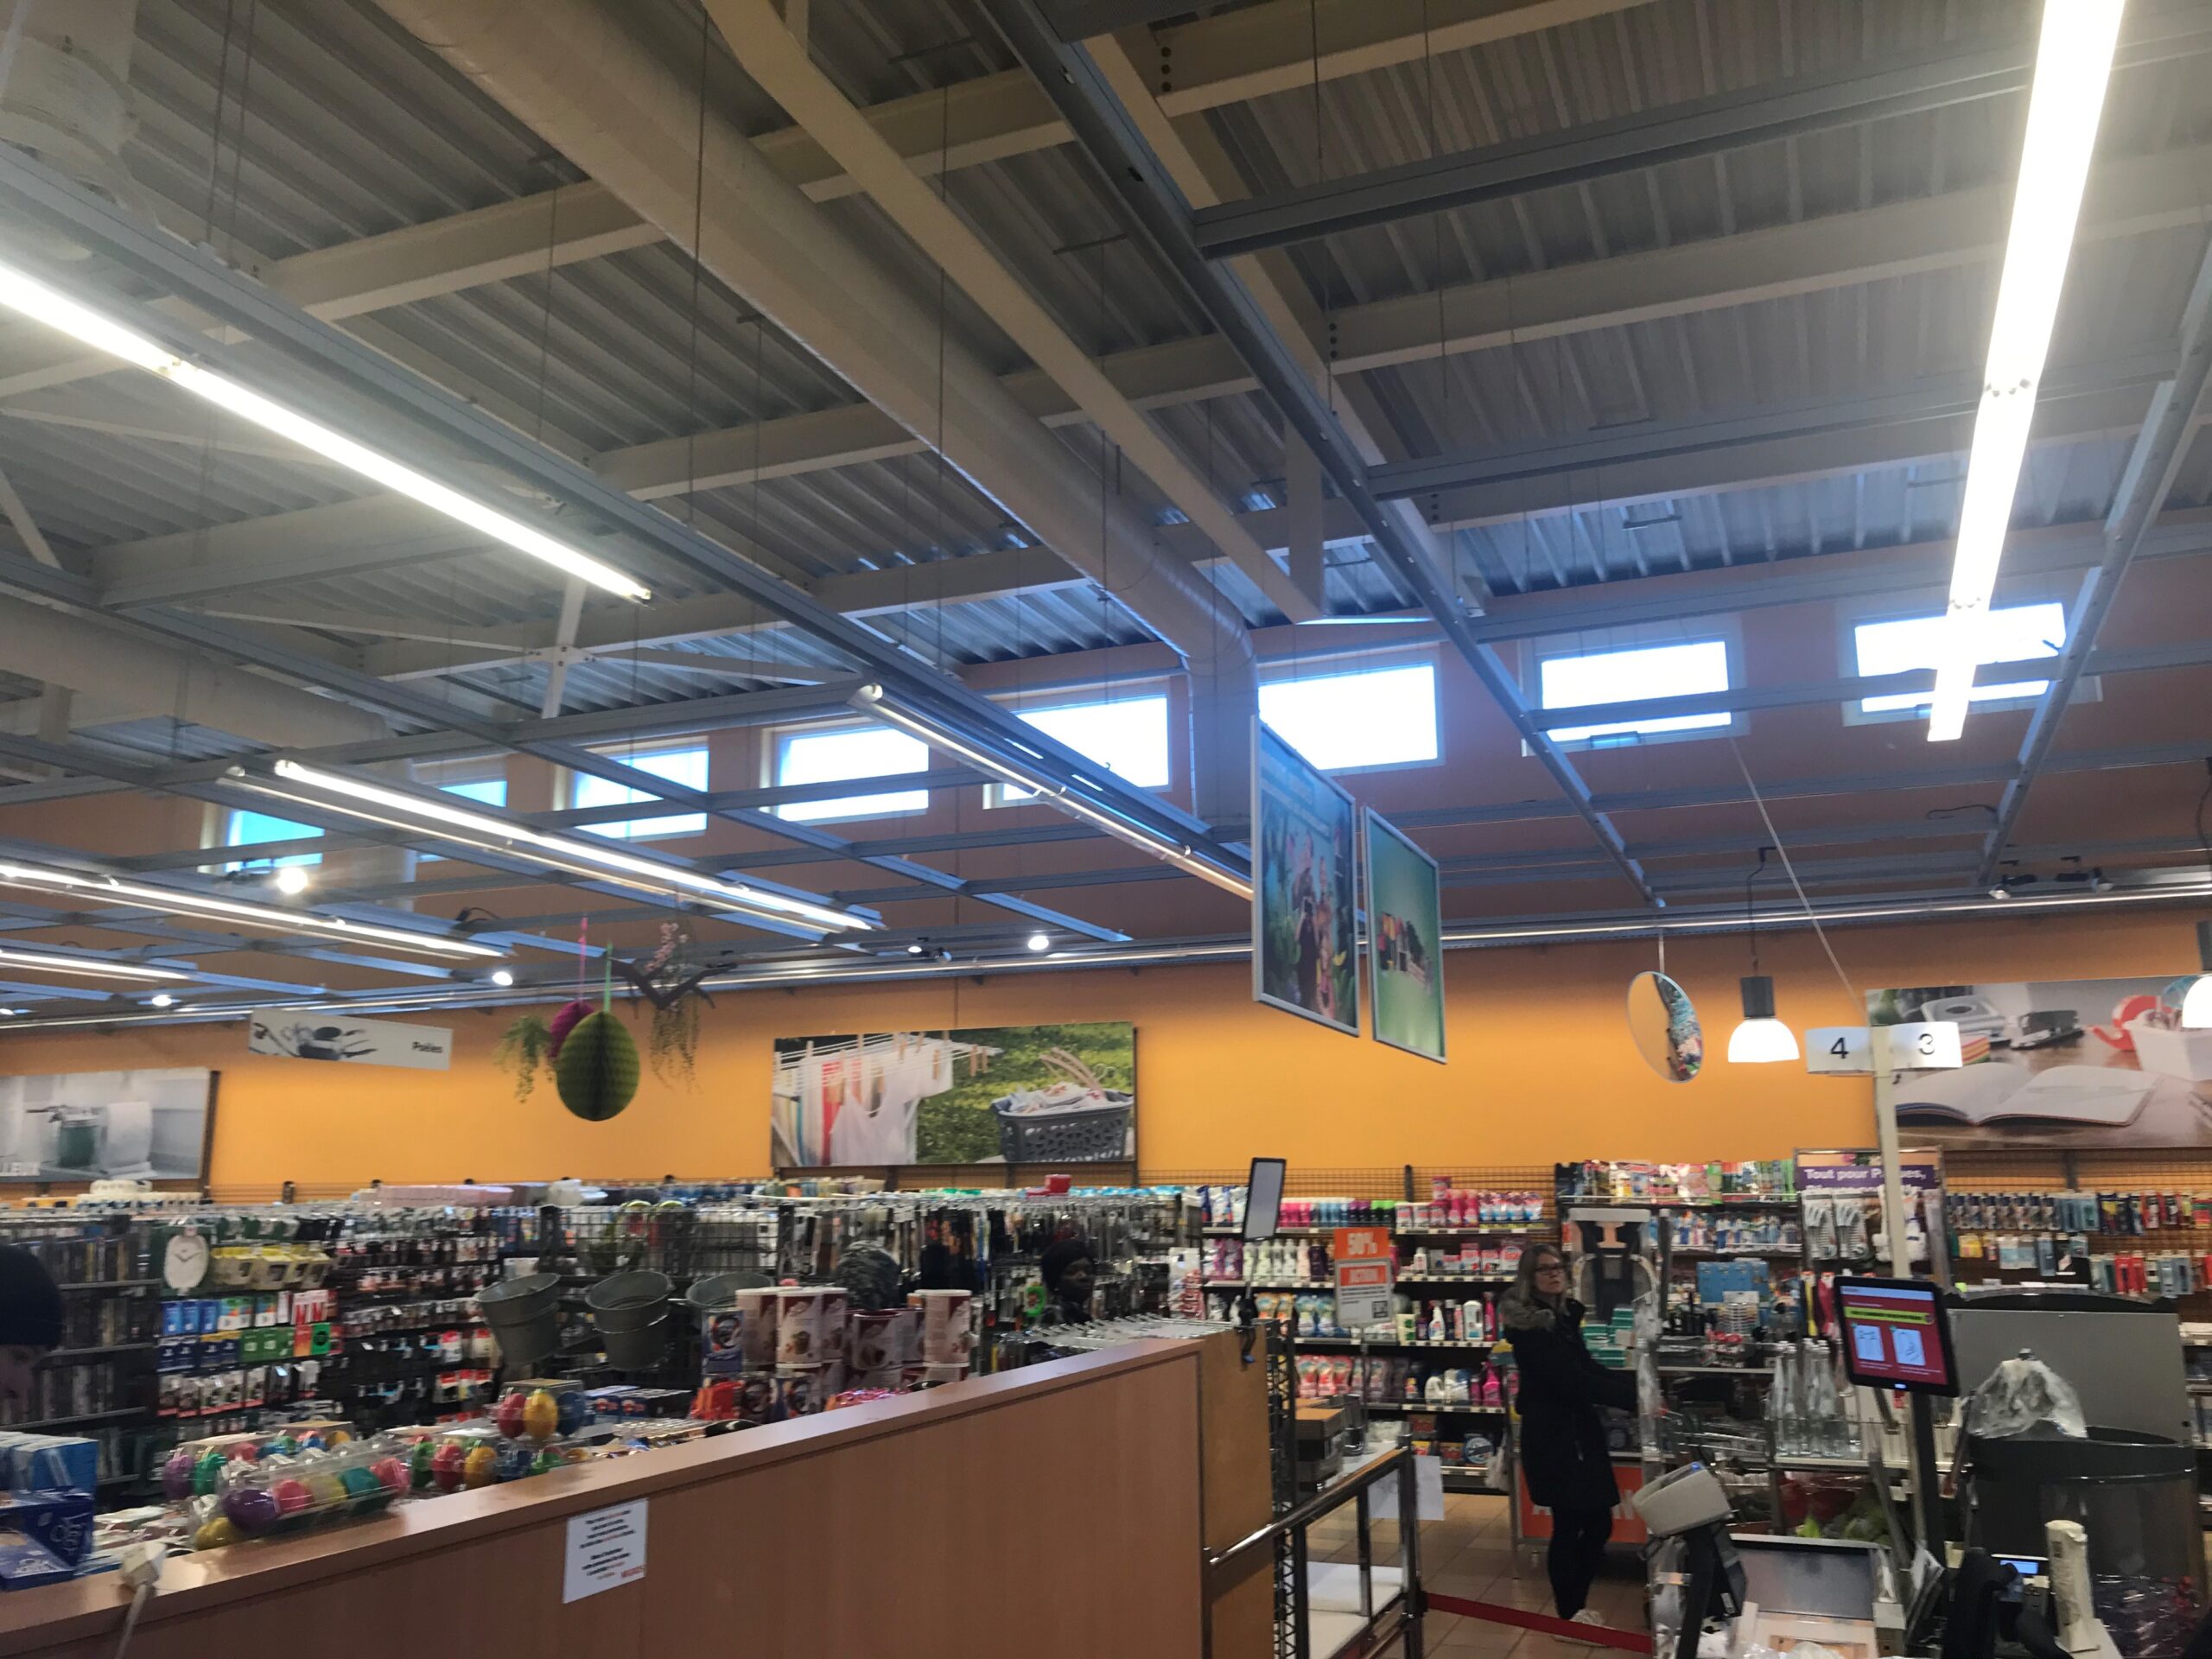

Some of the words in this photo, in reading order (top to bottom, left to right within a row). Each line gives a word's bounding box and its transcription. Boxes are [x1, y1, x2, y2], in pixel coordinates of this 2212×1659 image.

[1830, 1037, 1850, 1059] 4
[1918, 1033, 1936, 1055] 3
[1804, 1169, 1835, 1179] Tout
[1836, 1170, 1869, 1181] pour
